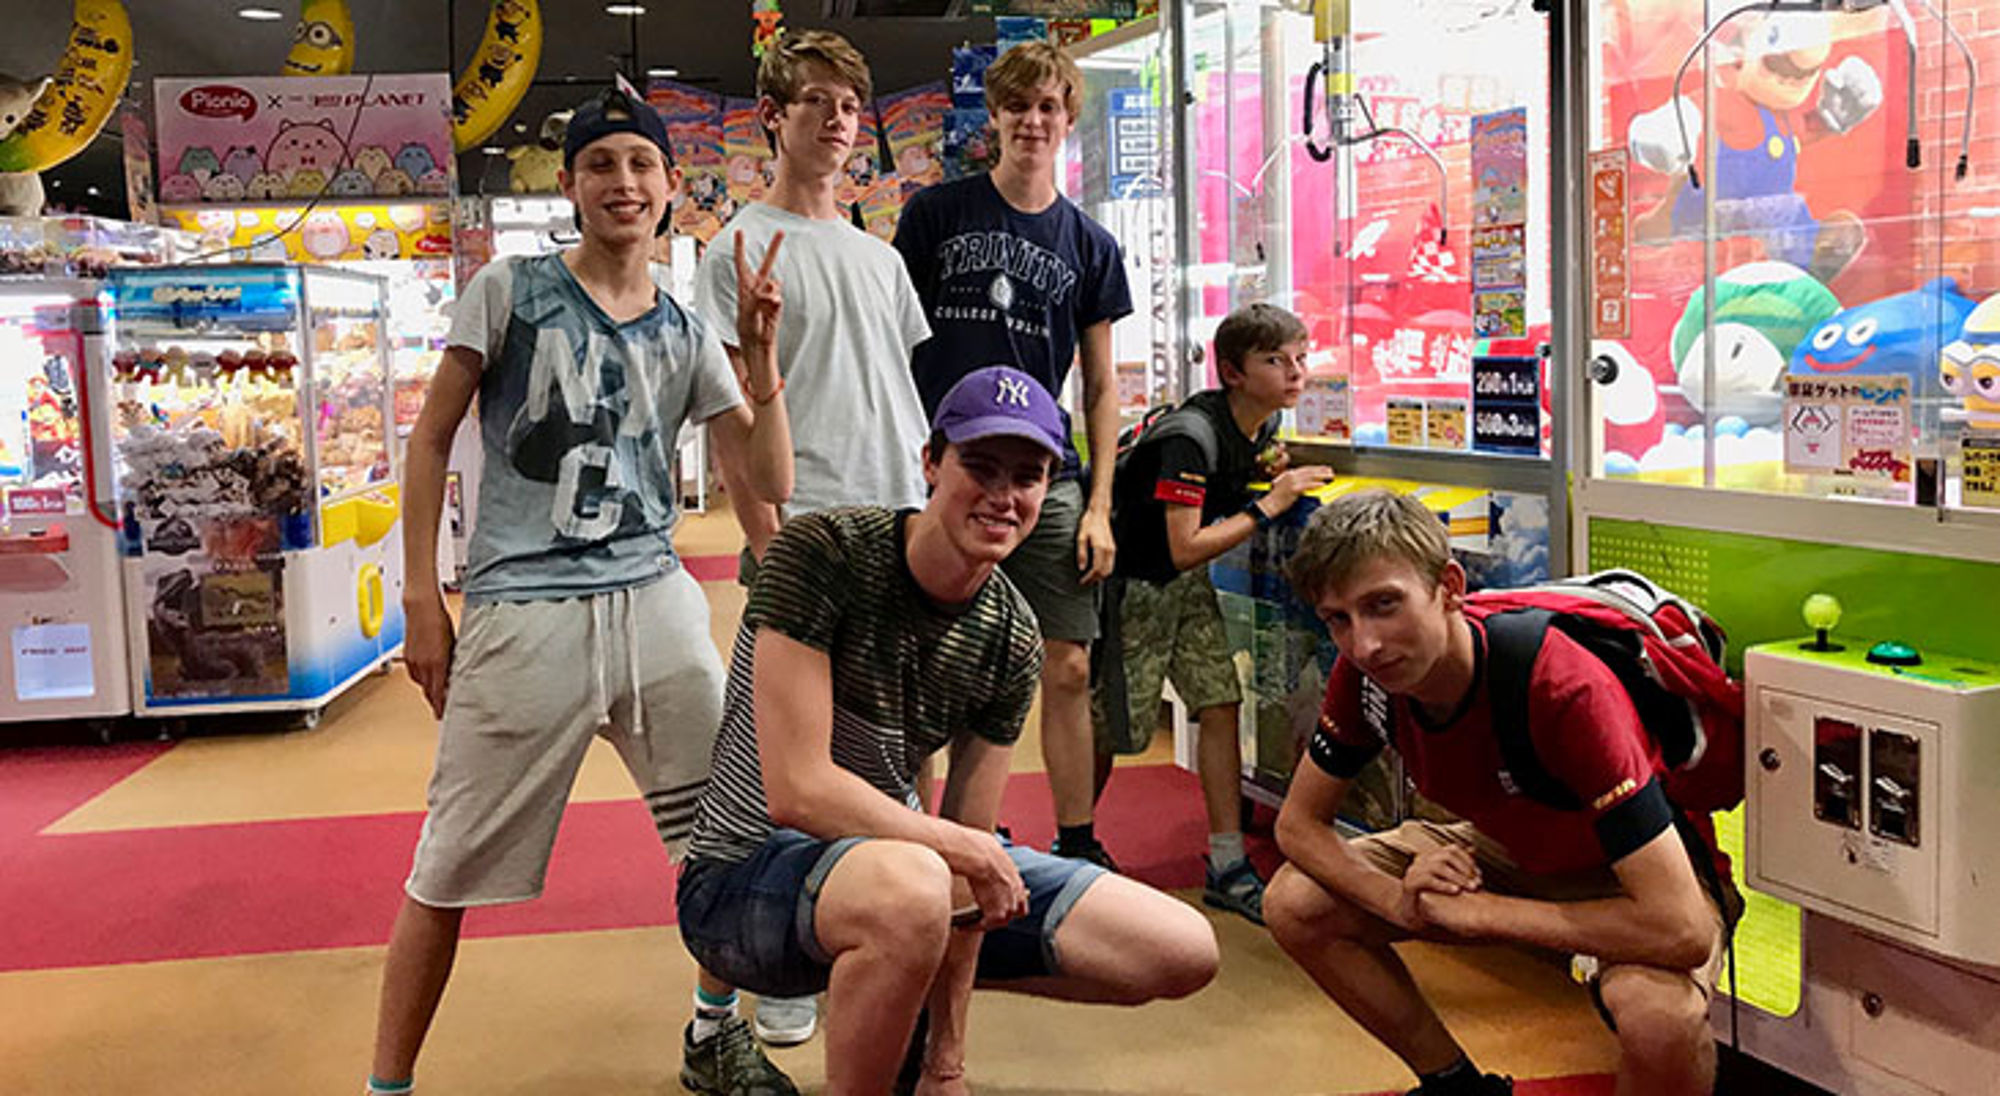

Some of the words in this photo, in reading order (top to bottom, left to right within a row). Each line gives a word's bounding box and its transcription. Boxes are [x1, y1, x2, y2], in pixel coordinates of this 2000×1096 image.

[939, 231, 1077, 305] TRINITY
[934, 306, 998, 321] COLLEGE
[996, 377, 1029, 407] NY
